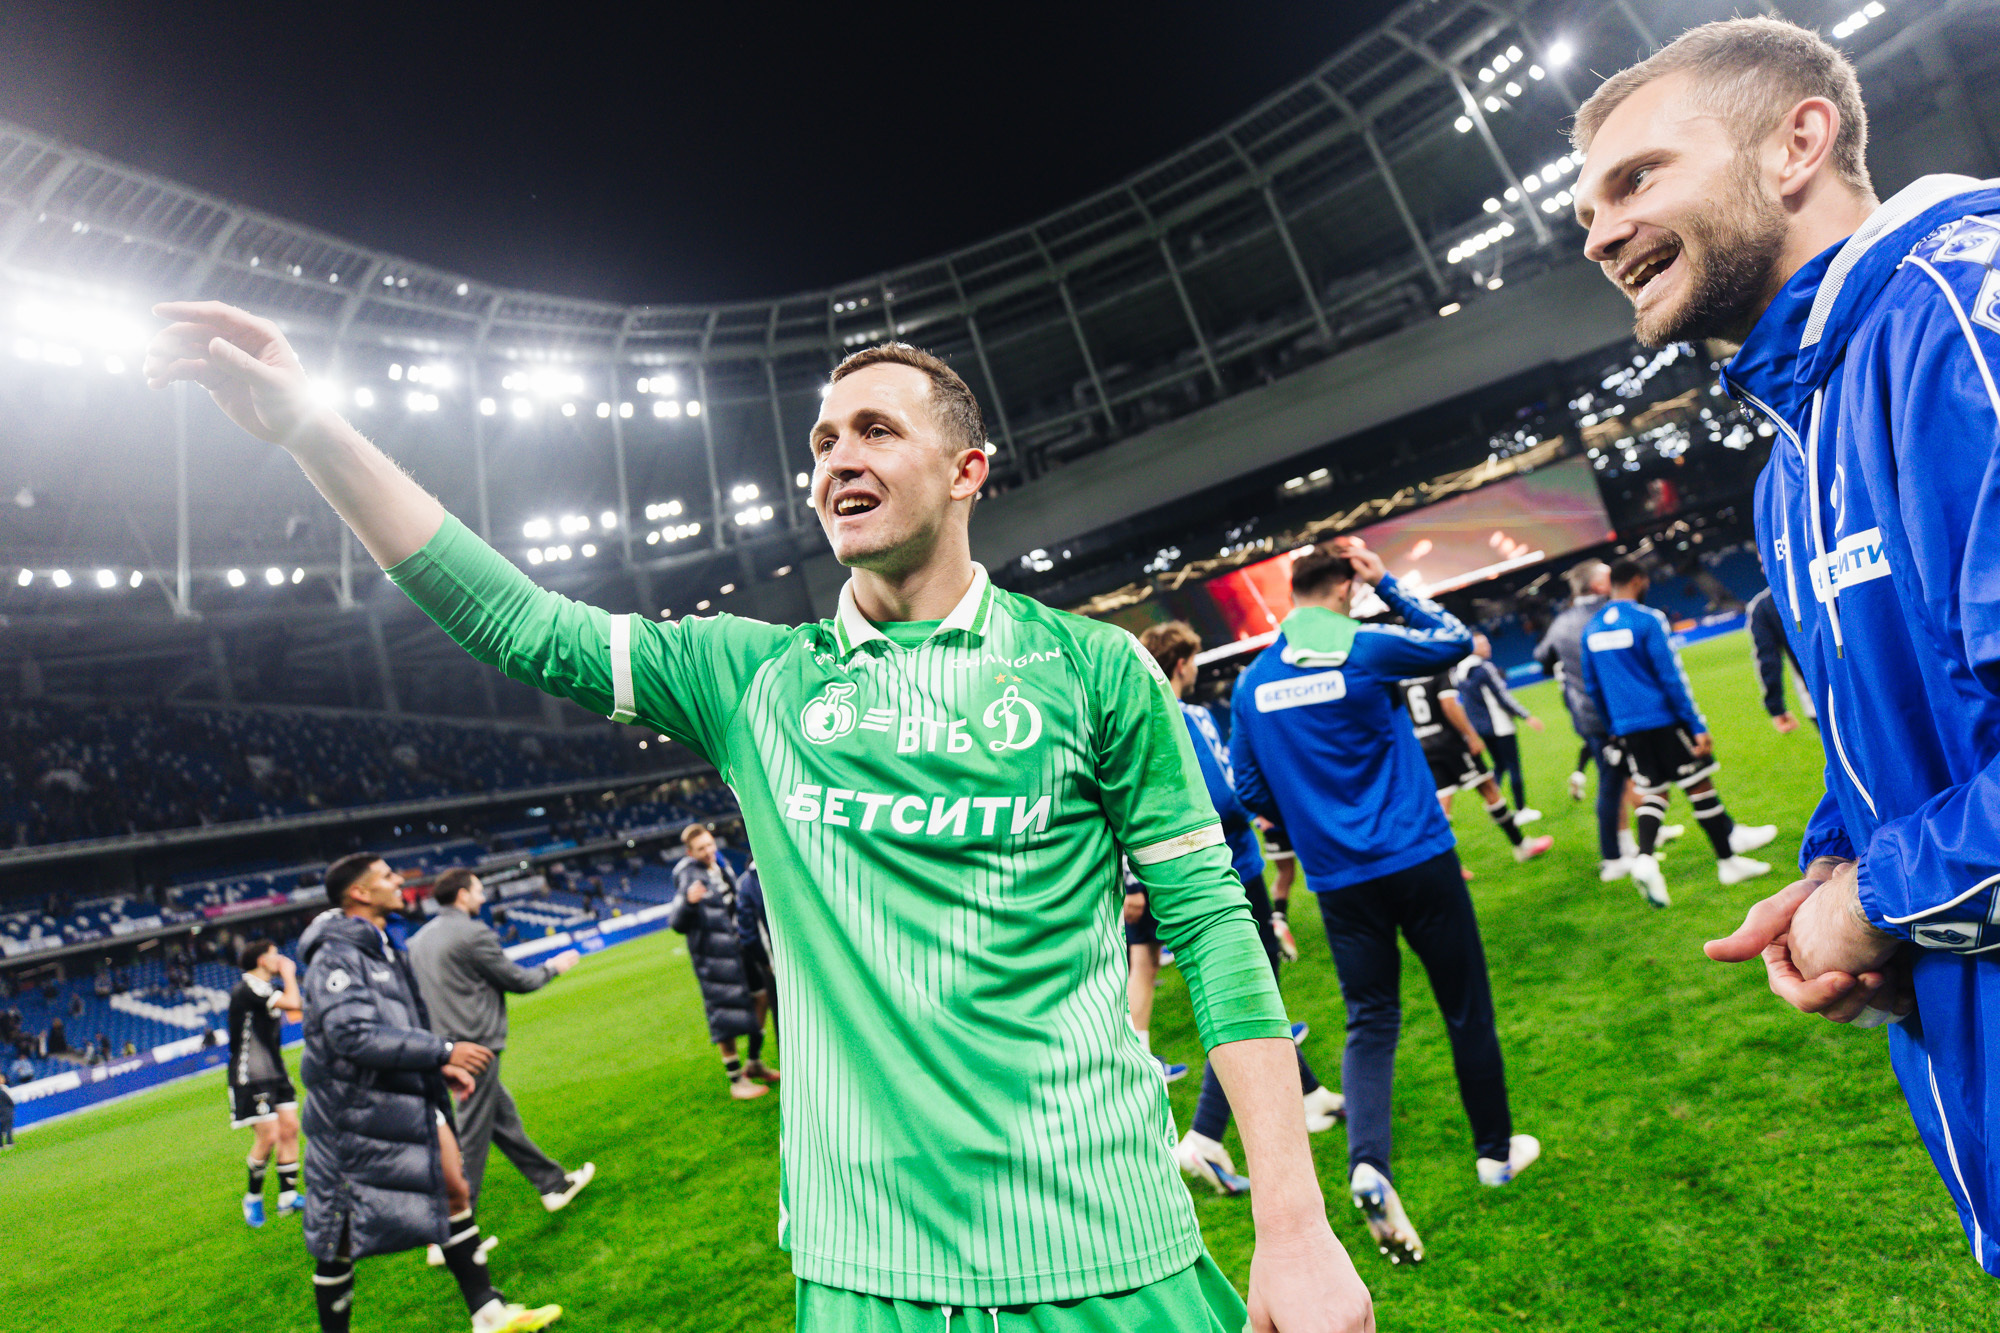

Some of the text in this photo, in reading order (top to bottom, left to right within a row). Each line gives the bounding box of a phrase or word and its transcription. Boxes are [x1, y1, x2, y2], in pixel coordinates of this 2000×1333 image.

[951, 646, 1061, 669] CHANGAN
[1264, 680, 1337, 703] БЕТСИТИ
[1407, 684, 1432, 725] 6
[896, 716, 973, 754] ВТБ
[784, 782, 1053, 837] БЕТСИТИ
